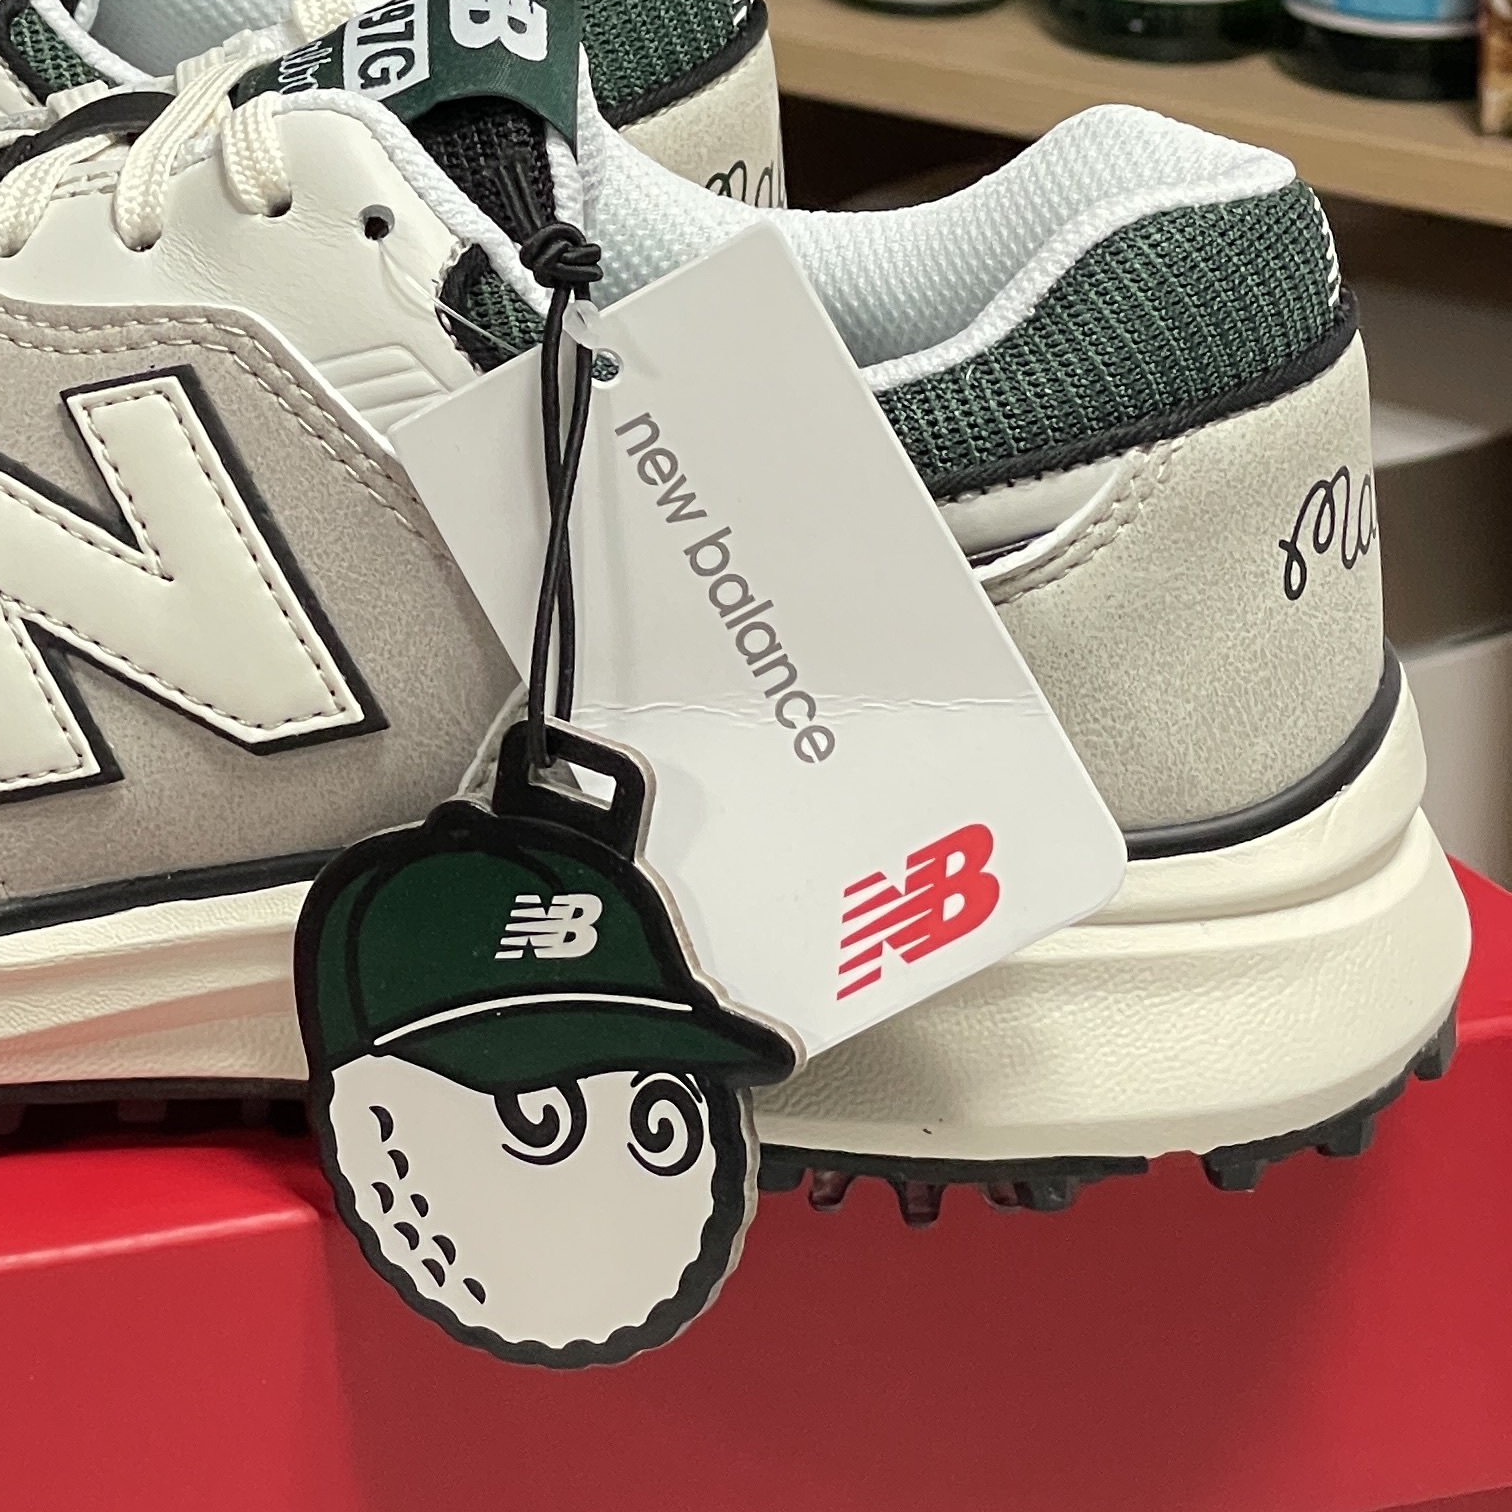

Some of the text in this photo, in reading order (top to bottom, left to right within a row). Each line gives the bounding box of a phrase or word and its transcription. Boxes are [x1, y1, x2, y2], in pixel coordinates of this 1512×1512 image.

[614, 411, 836, 765] new balance
[494, 893, 603, 960] NB
[836, 823, 1001, 1001] NB
